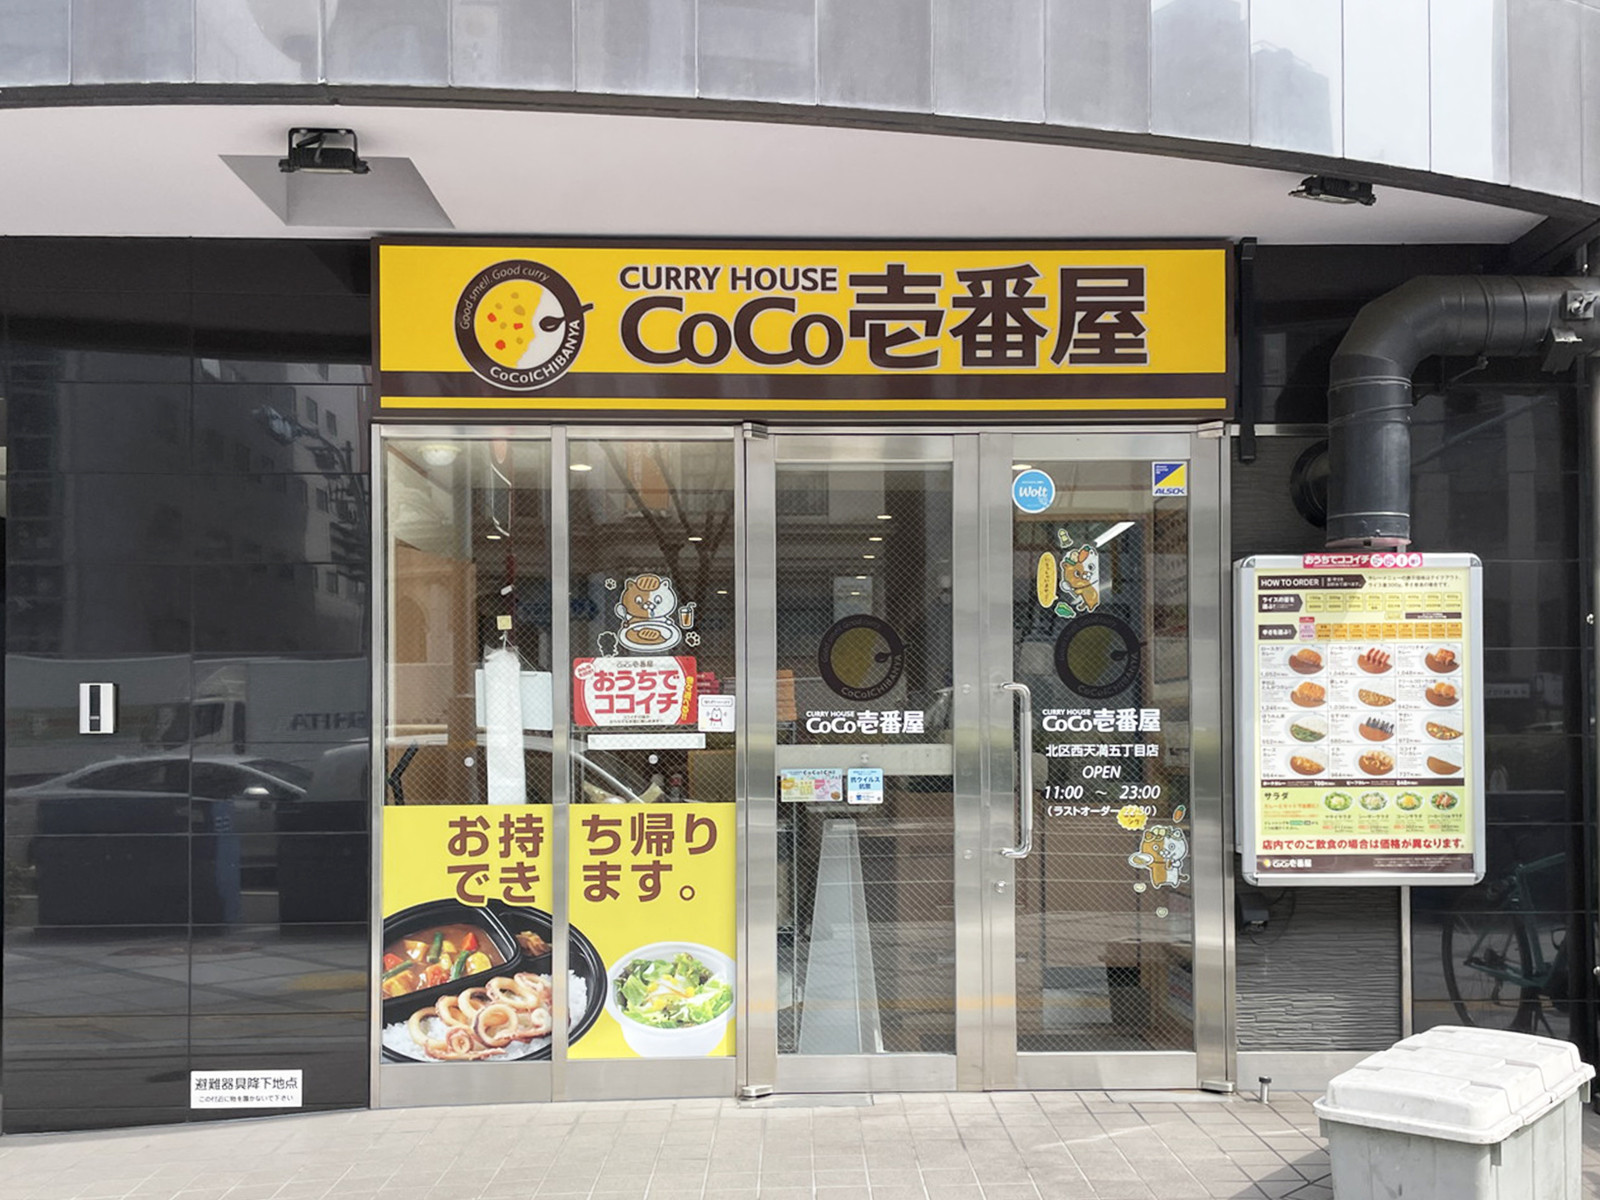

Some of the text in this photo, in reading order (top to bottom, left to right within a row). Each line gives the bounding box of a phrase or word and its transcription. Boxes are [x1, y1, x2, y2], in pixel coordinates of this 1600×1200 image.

[619, 266, 839, 292] CURRY HOUSE
[460, 299, 473, 330] Good
[492, 266, 521, 280] Good
[522, 267, 550, 281] curry
[620, 263, 1150, 371] CoCo壱番屋
[490, 320, 580, 383] CoCoICHIBANYA
[1019, 486, 1048, 497] Wolt
[1155, 487, 1185, 495] ALSOK
[1304, 555, 1370, 565] おうちでココイチ
[1261, 578, 1319, 587] HOW TO ORDER
[593, 670, 680, 691] おうちで
[594, 693, 678, 714] ココイチ
[806, 710, 925, 735] CoCo壱番屋
[1042, 707, 1161, 732] CoCo壱番屋
[1045, 744, 1159, 758] 北区西天満五丁目店
[1082, 765, 1121, 779] OPEN
[1044, 785, 1084, 800] 11:00
[1119, 785, 1161, 800] 23:00
[1264, 792, 1289, 800] サラダ
[1262, 838, 1465, 850] 店内でのご飲食の場合は価格が異なります。
[195, 1077, 298, 1091] 避難器具降下地点
